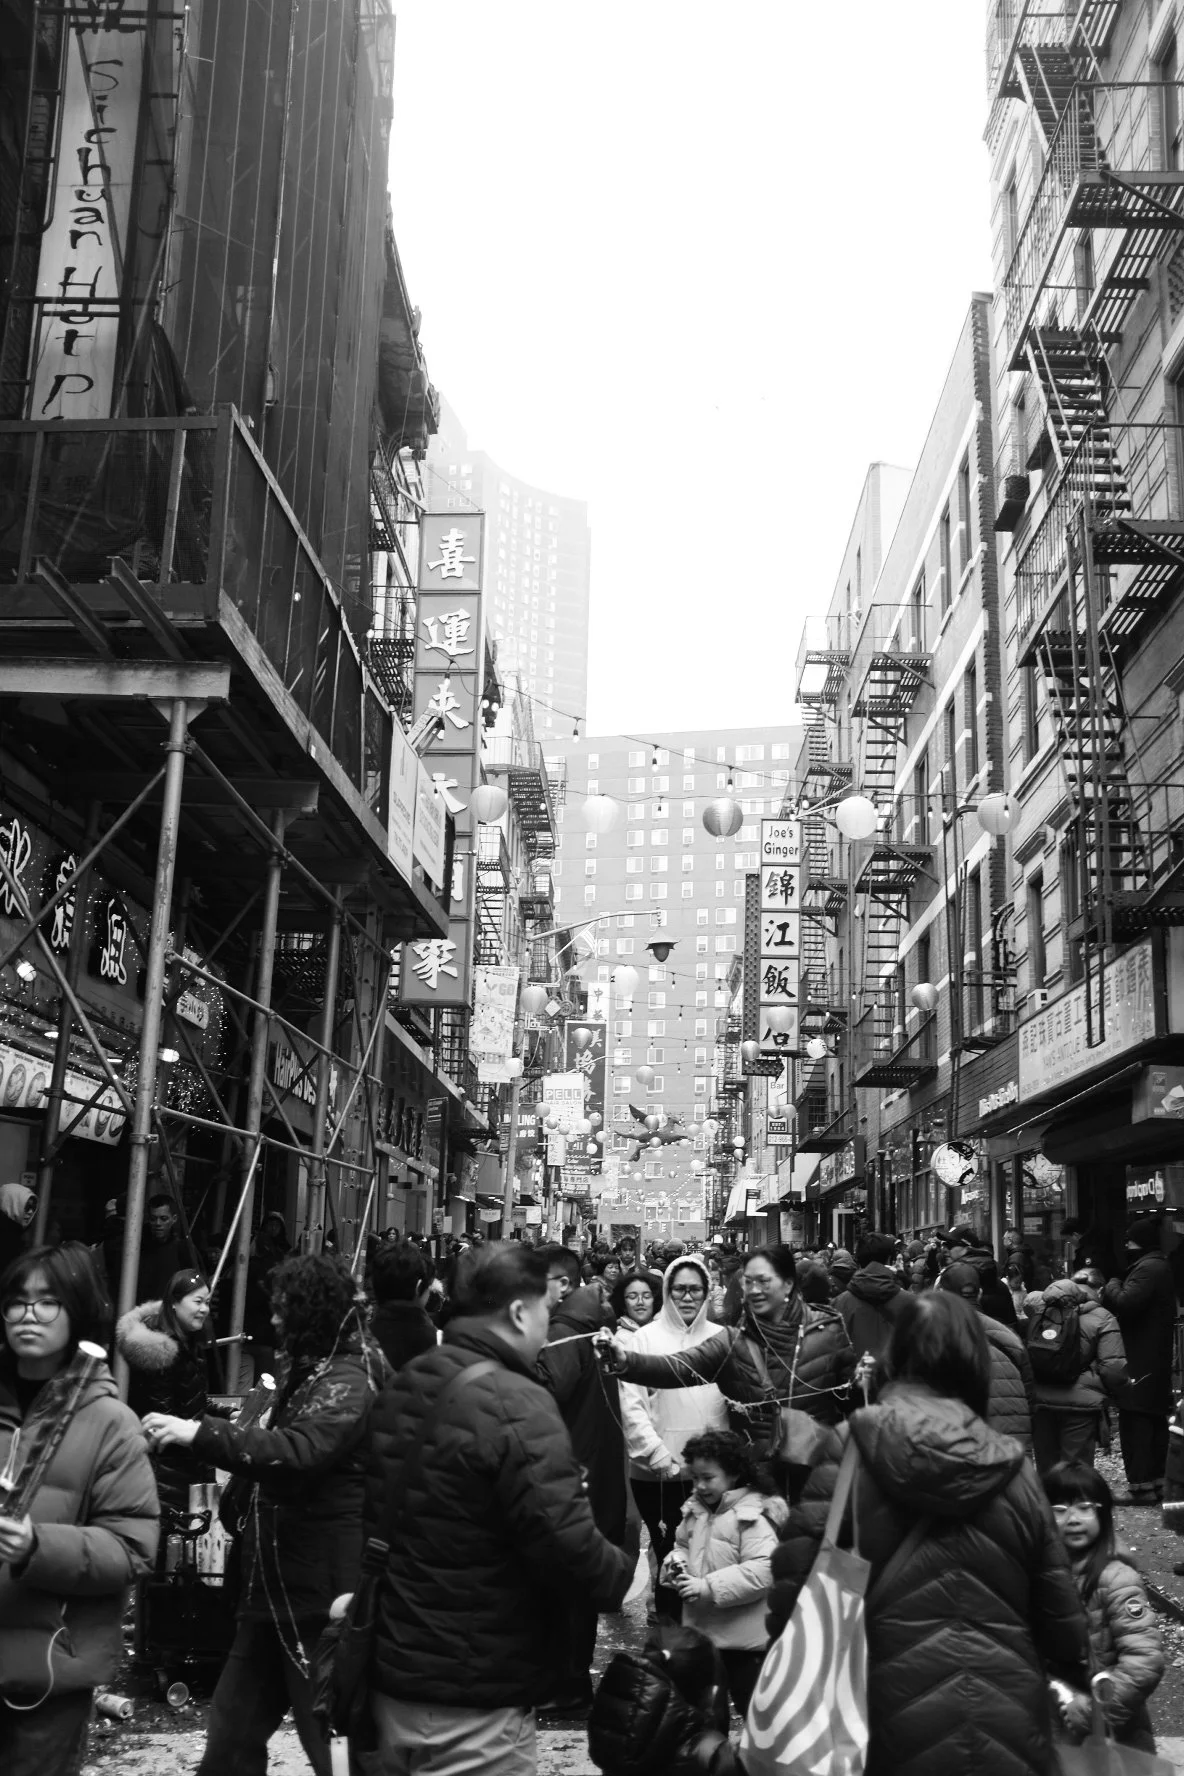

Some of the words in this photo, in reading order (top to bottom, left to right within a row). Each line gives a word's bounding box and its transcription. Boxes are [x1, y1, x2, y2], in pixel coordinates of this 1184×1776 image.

[70, 59, 123, 250] Sichuan
[41, 373, 94, 419] P
[769, 826, 794, 838] Joe's
[763, 841, 799, 858] Ginger
[770, 1082, 784, 1090] Bar
[547, 1088, 584, 1100] PELL
